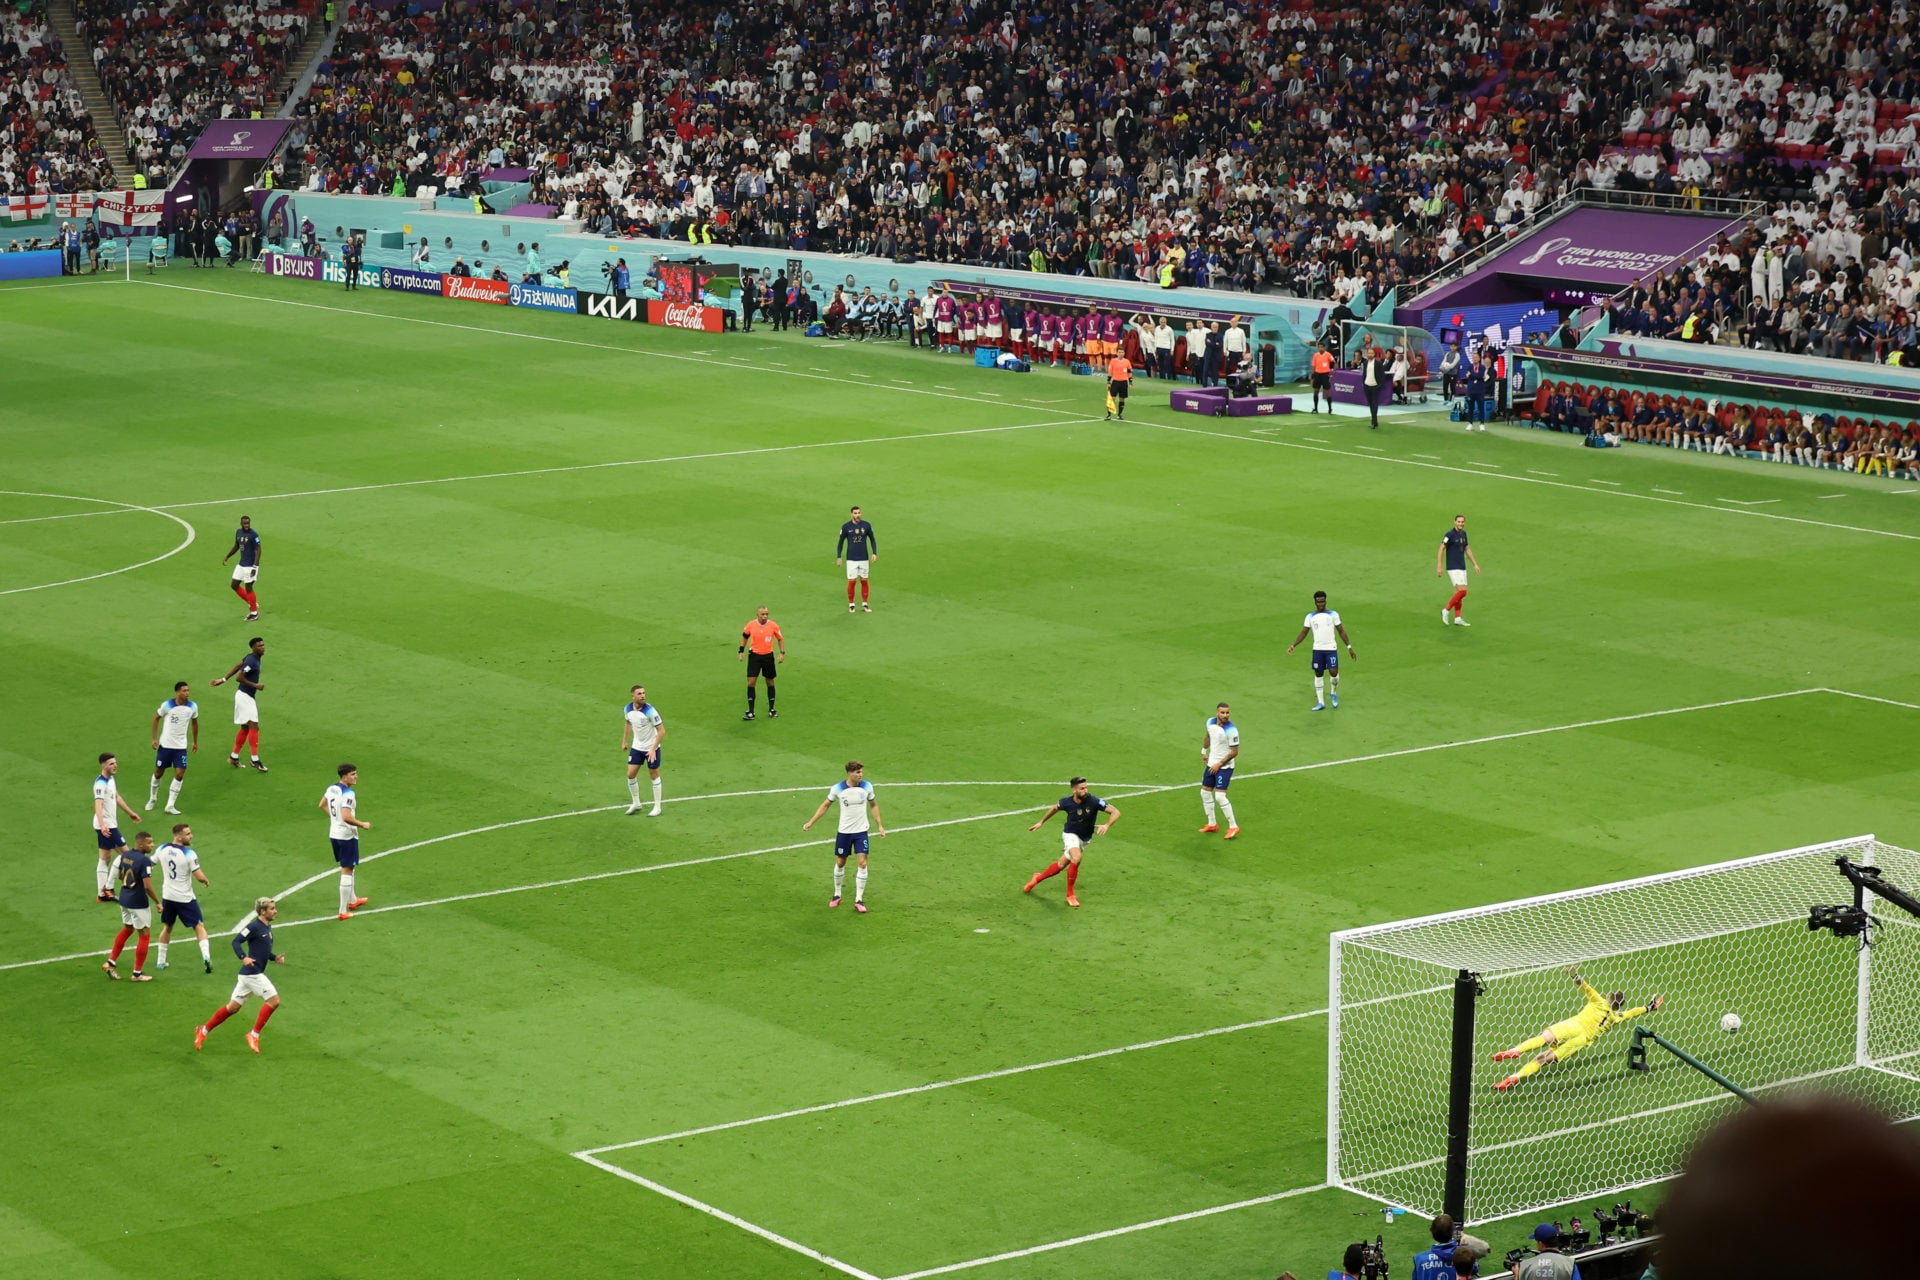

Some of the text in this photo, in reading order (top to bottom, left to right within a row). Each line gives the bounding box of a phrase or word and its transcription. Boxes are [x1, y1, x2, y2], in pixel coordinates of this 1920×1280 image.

[103, 201, 157, 213] CHIZZY FC
[1562, 247, 1595, 256] FIFA
[1593, 249, 1646, 261] WORLD
[284, 258, 314, 277] BYJU'S
[1606, 260, 1655, 272] 2022
[393, 274, 442, 291] crypto.com
[1469, 338, 1514, 352] Frnce
[1217, 775, 1223, 784] 2
[330, 798, 337, 817] 6
[168, 859, 177, 880] 3
[1421, 1260, 1443, 1271] TEAM
